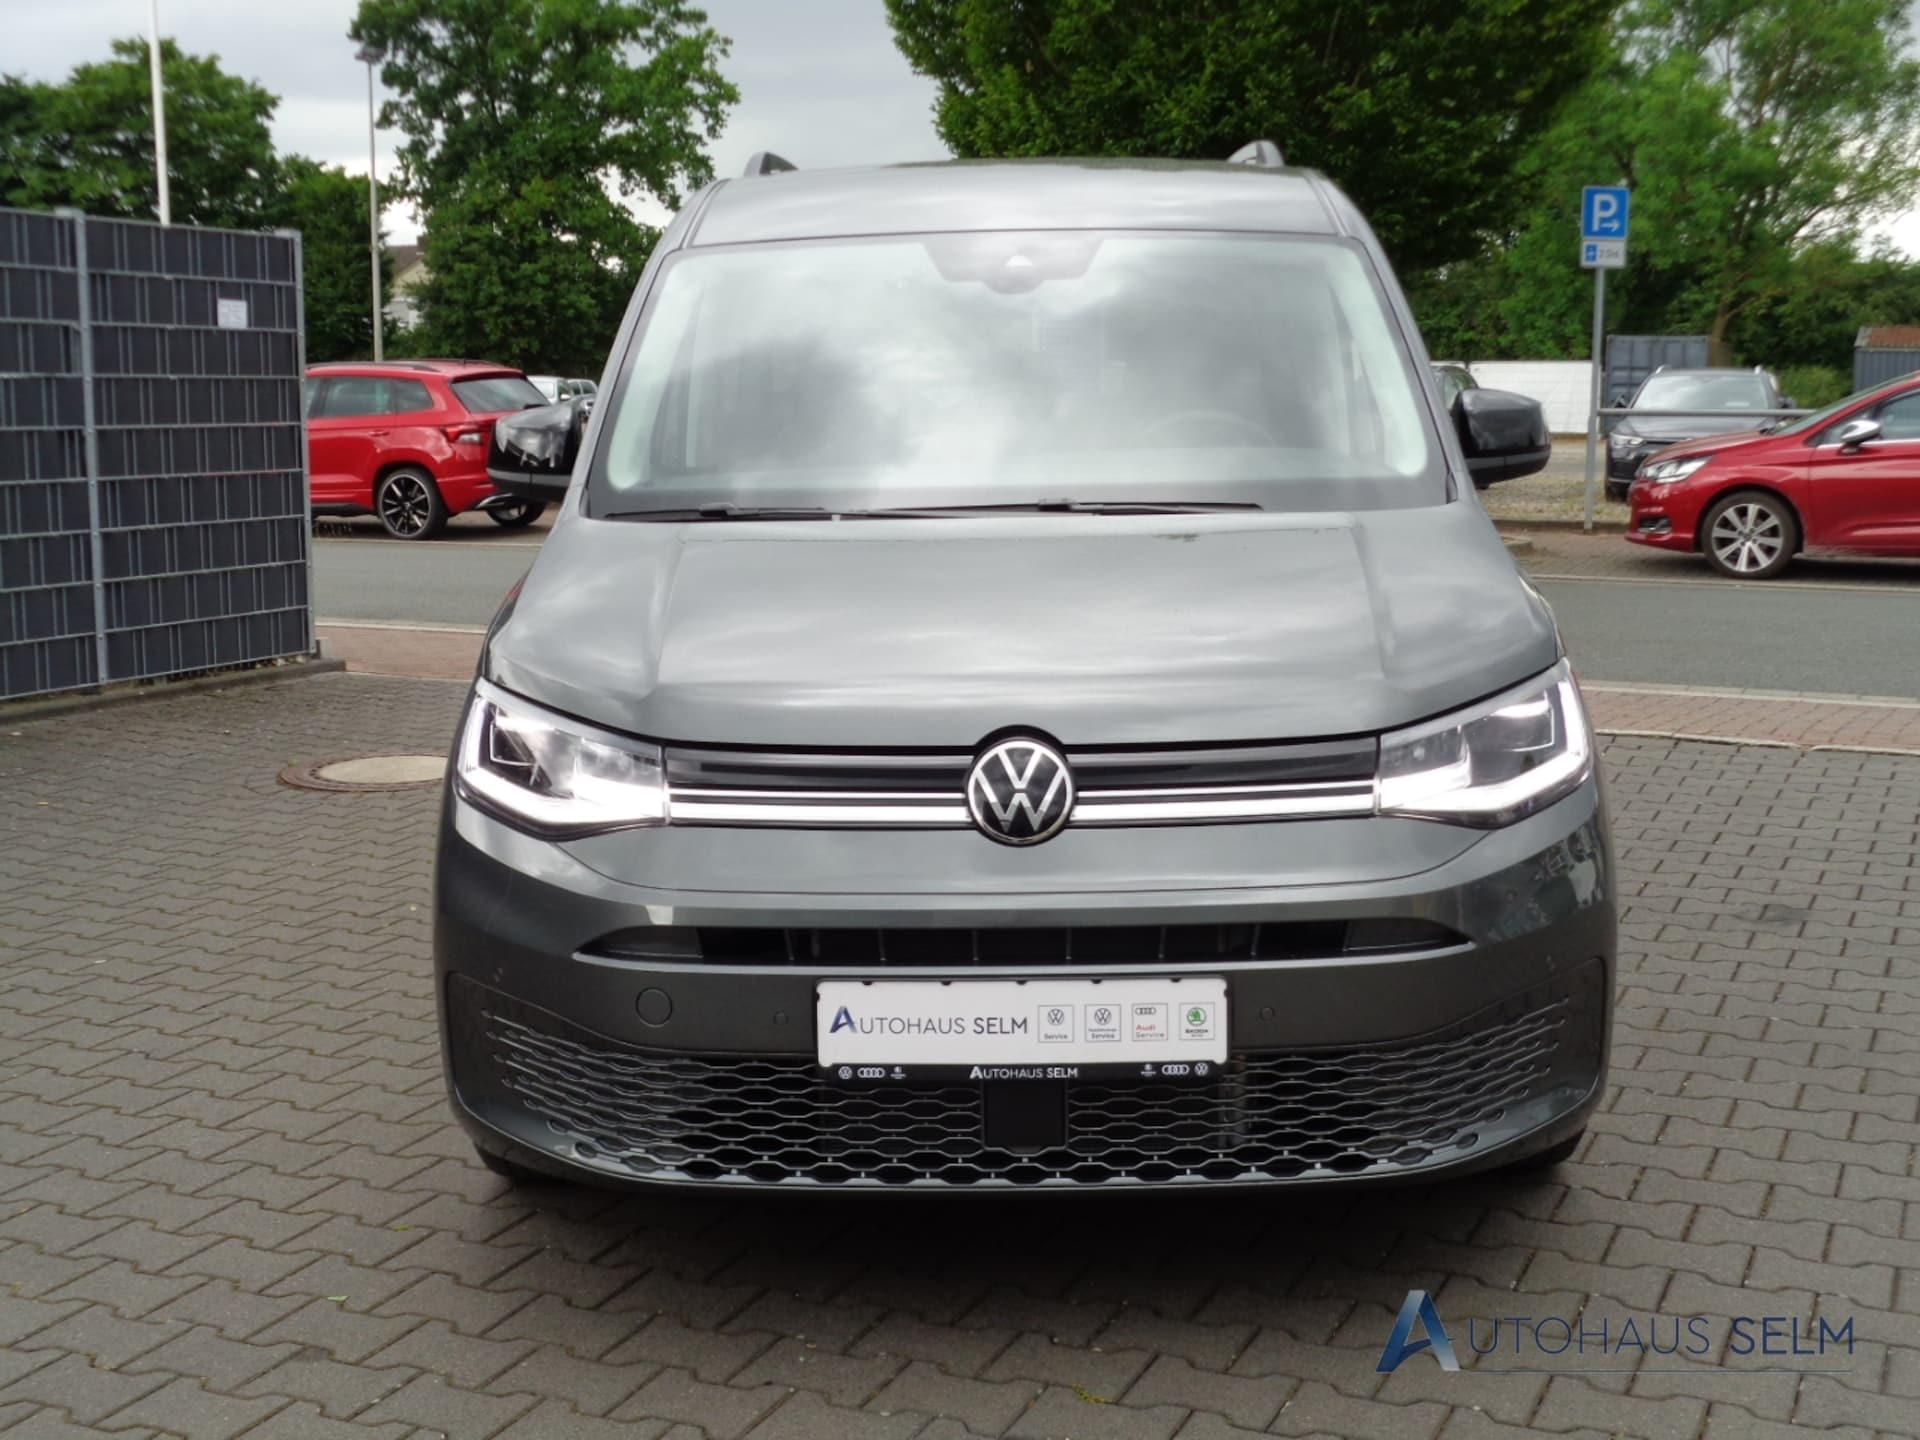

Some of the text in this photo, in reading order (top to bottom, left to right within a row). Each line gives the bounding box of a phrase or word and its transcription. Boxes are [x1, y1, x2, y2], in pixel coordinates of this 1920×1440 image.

[1592, 193, 1617, 232] P
[829, 1006, 1028, 1035] AUTOHAUS SELM
[969, 1065, 1079, 1080] AUTOHAUS SELM
